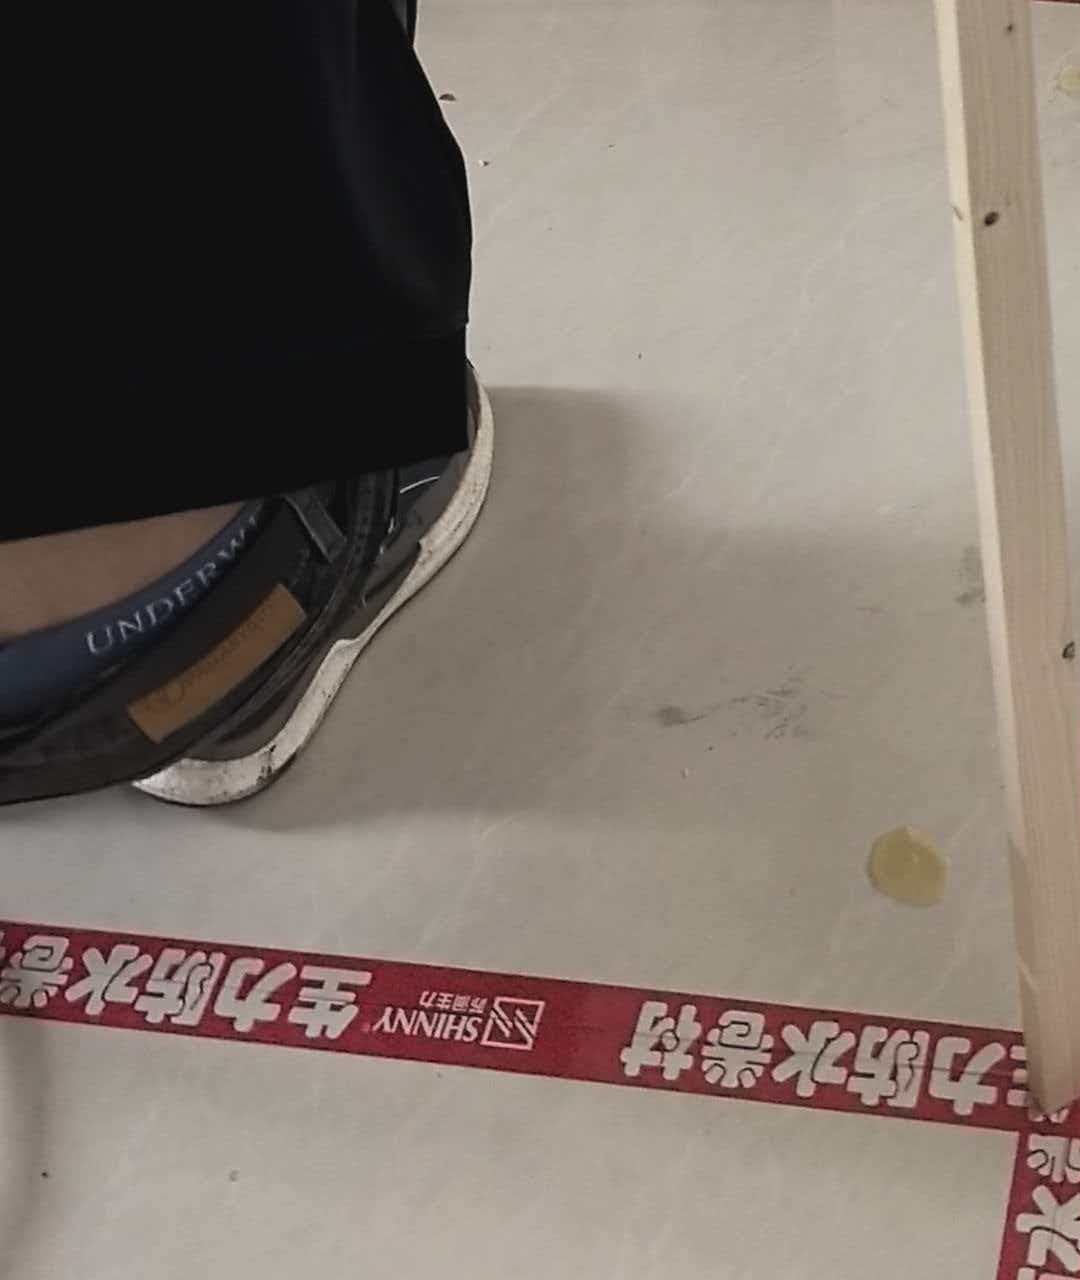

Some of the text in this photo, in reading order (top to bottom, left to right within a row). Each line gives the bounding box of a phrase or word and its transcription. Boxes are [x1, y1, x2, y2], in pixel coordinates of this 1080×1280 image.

[0, 933, 373, 1039] 生力防水卷
[372, 1006, 484, 1043] SHINNY
